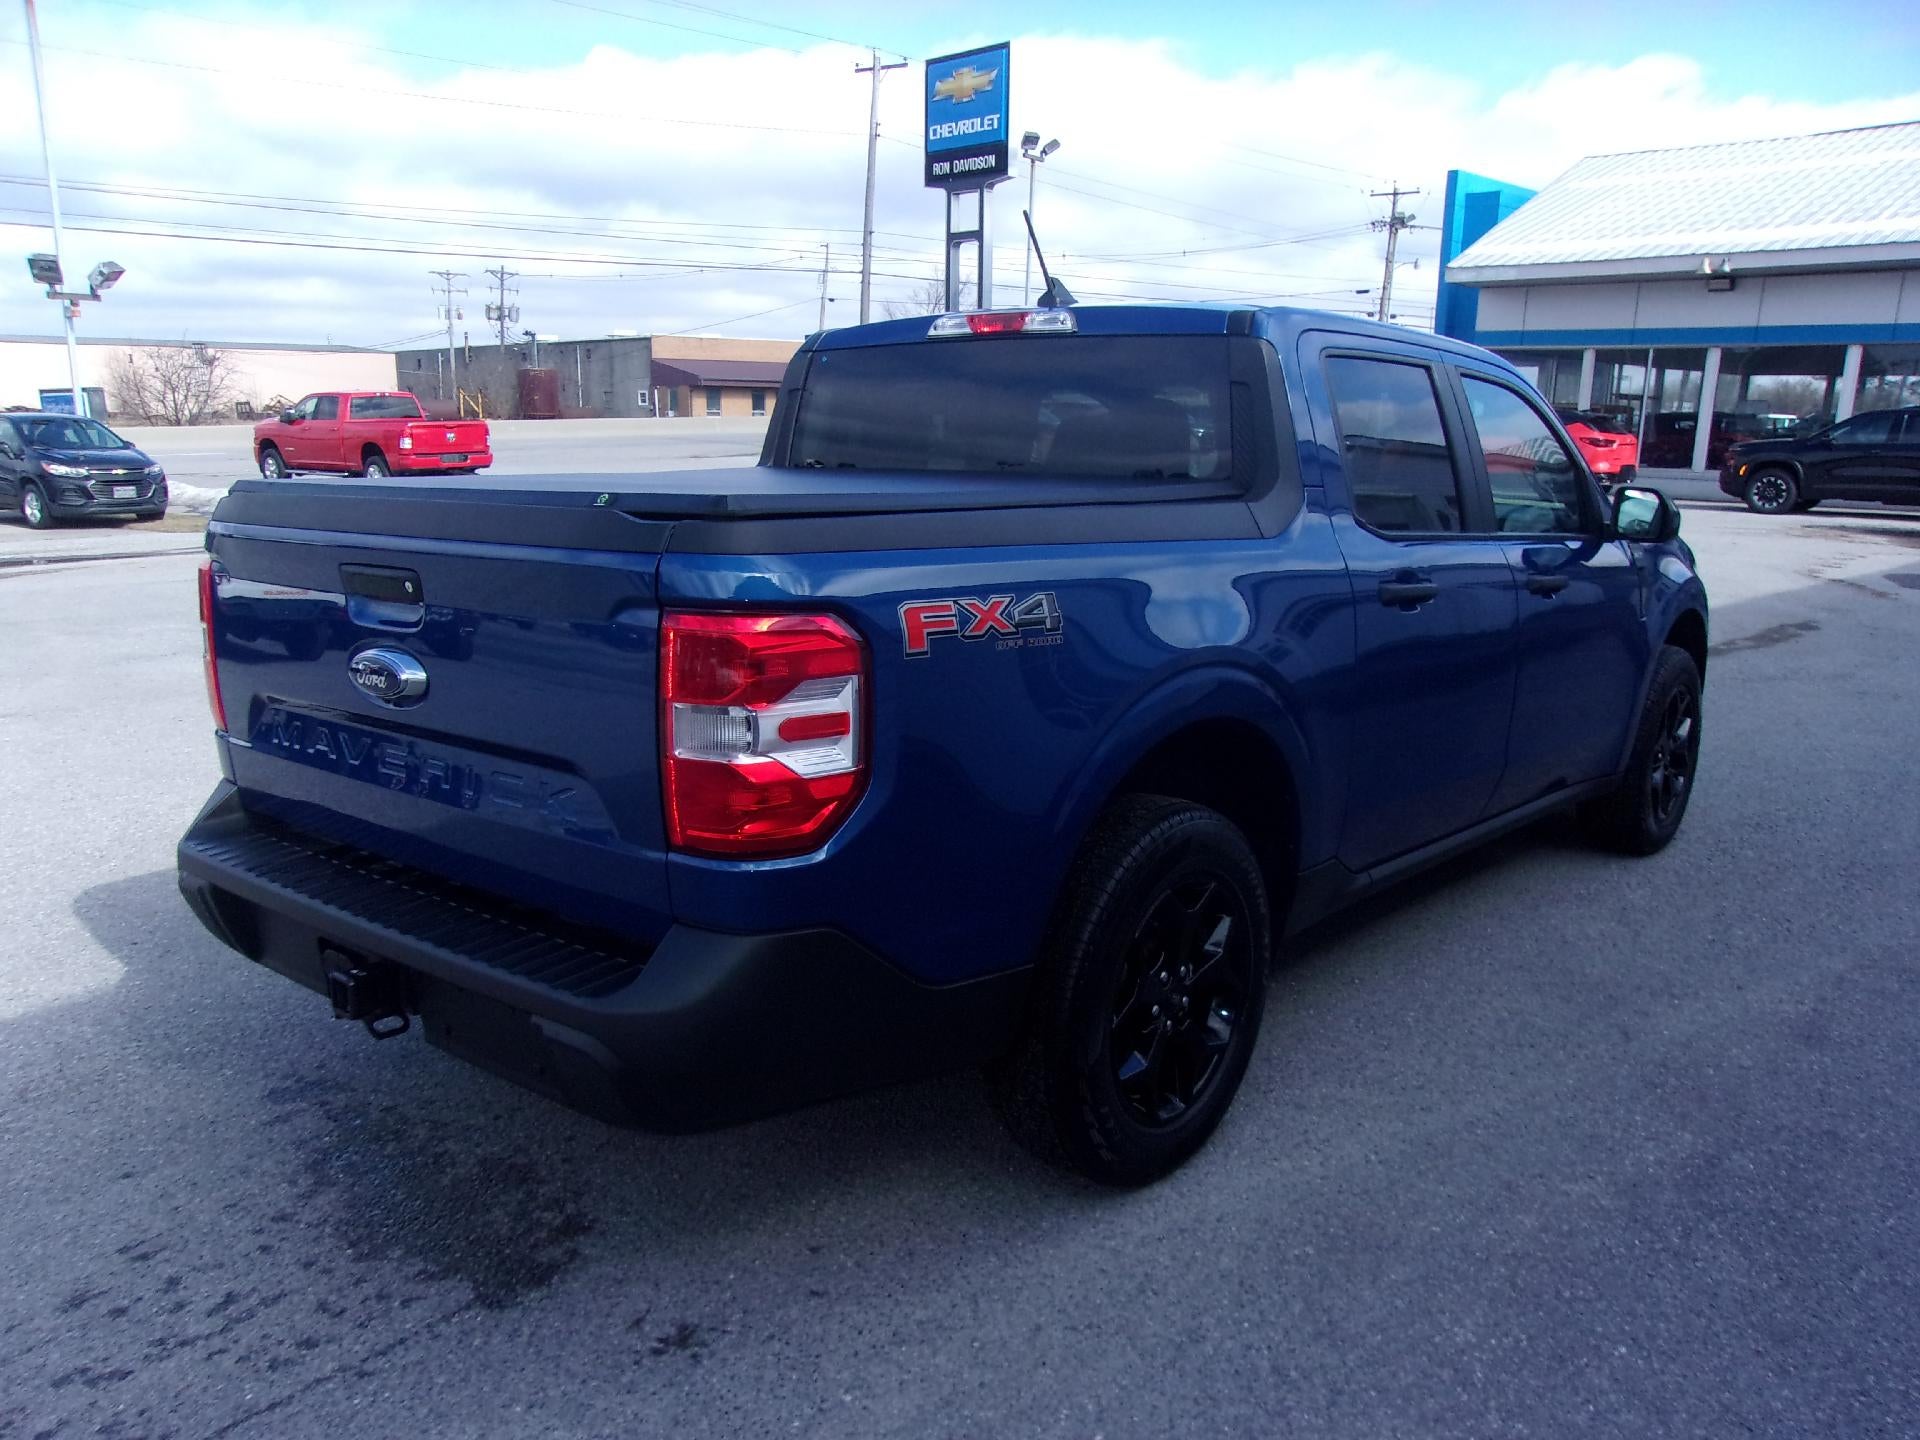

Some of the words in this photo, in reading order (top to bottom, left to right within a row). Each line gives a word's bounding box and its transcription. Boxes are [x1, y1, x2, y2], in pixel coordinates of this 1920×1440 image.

[929, 114, 1000, 140] CHEVROLET
[932, 162, 950, 176] RON
[953, 154, 996, 173] DAVIDSON
[897, 592, 1063, 659] FX4
[352, 661, 388, 689] Ford
[272, 713, 578, 822] MAVERICK
